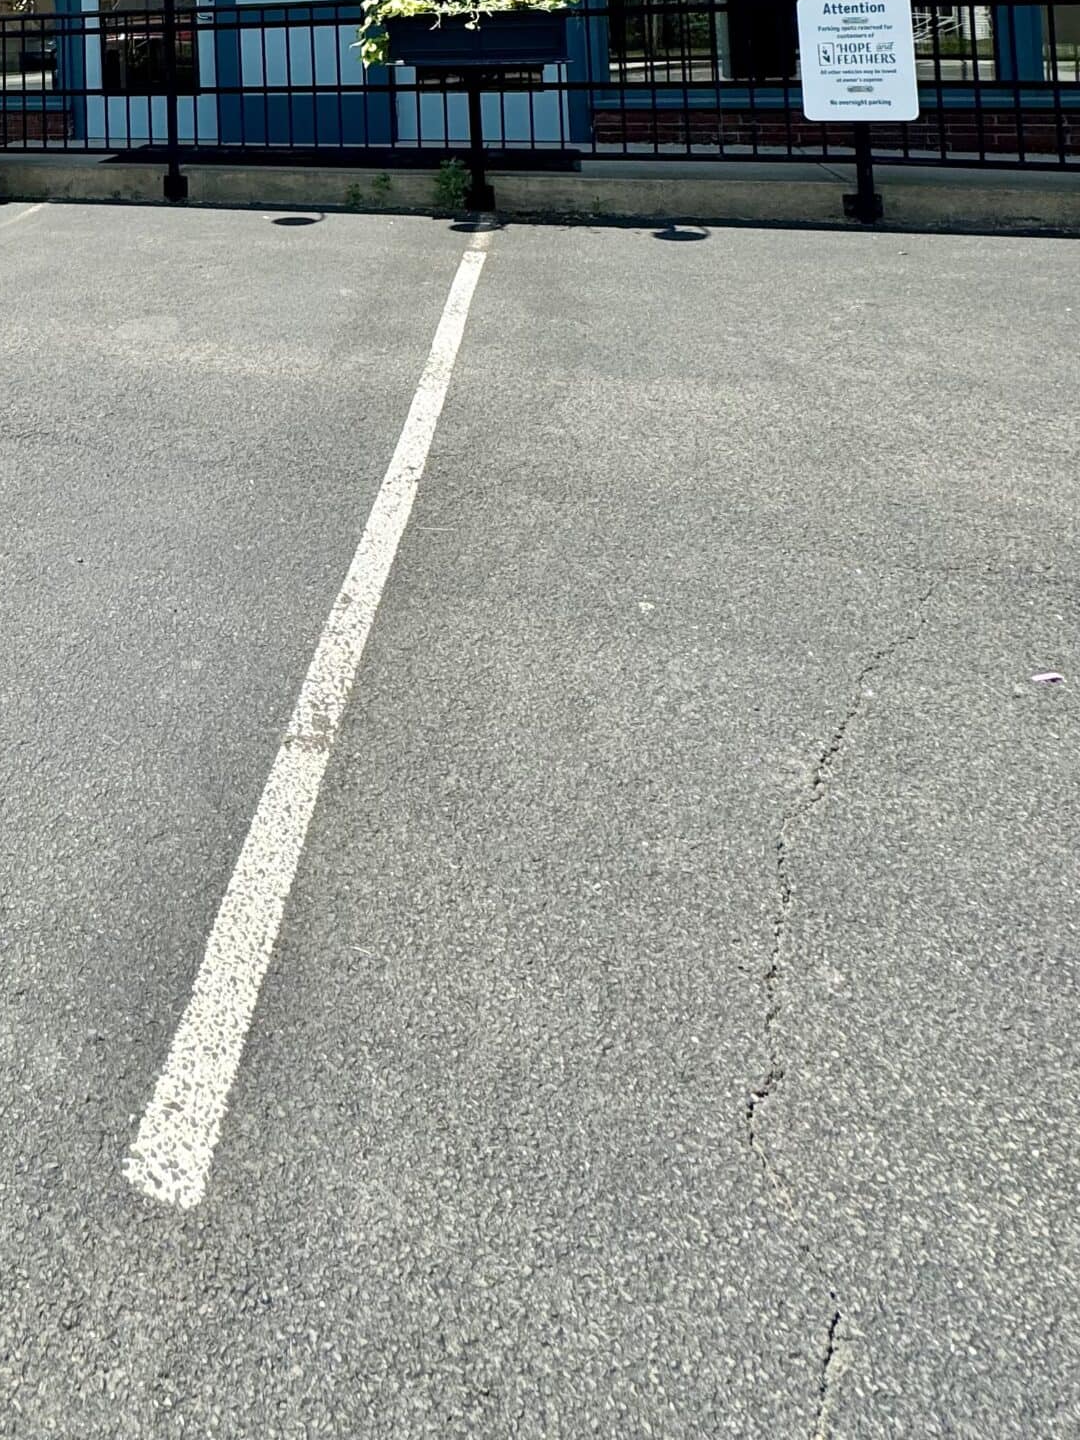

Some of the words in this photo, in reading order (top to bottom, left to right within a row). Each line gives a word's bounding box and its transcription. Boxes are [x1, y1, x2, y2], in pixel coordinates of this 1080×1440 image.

[823, 2, 886, 15] Attention
[836, 42, 872, 53] HOPE
[837, 53, 897, 65] FEATHERS
[868, 99, 892, 107] parking
